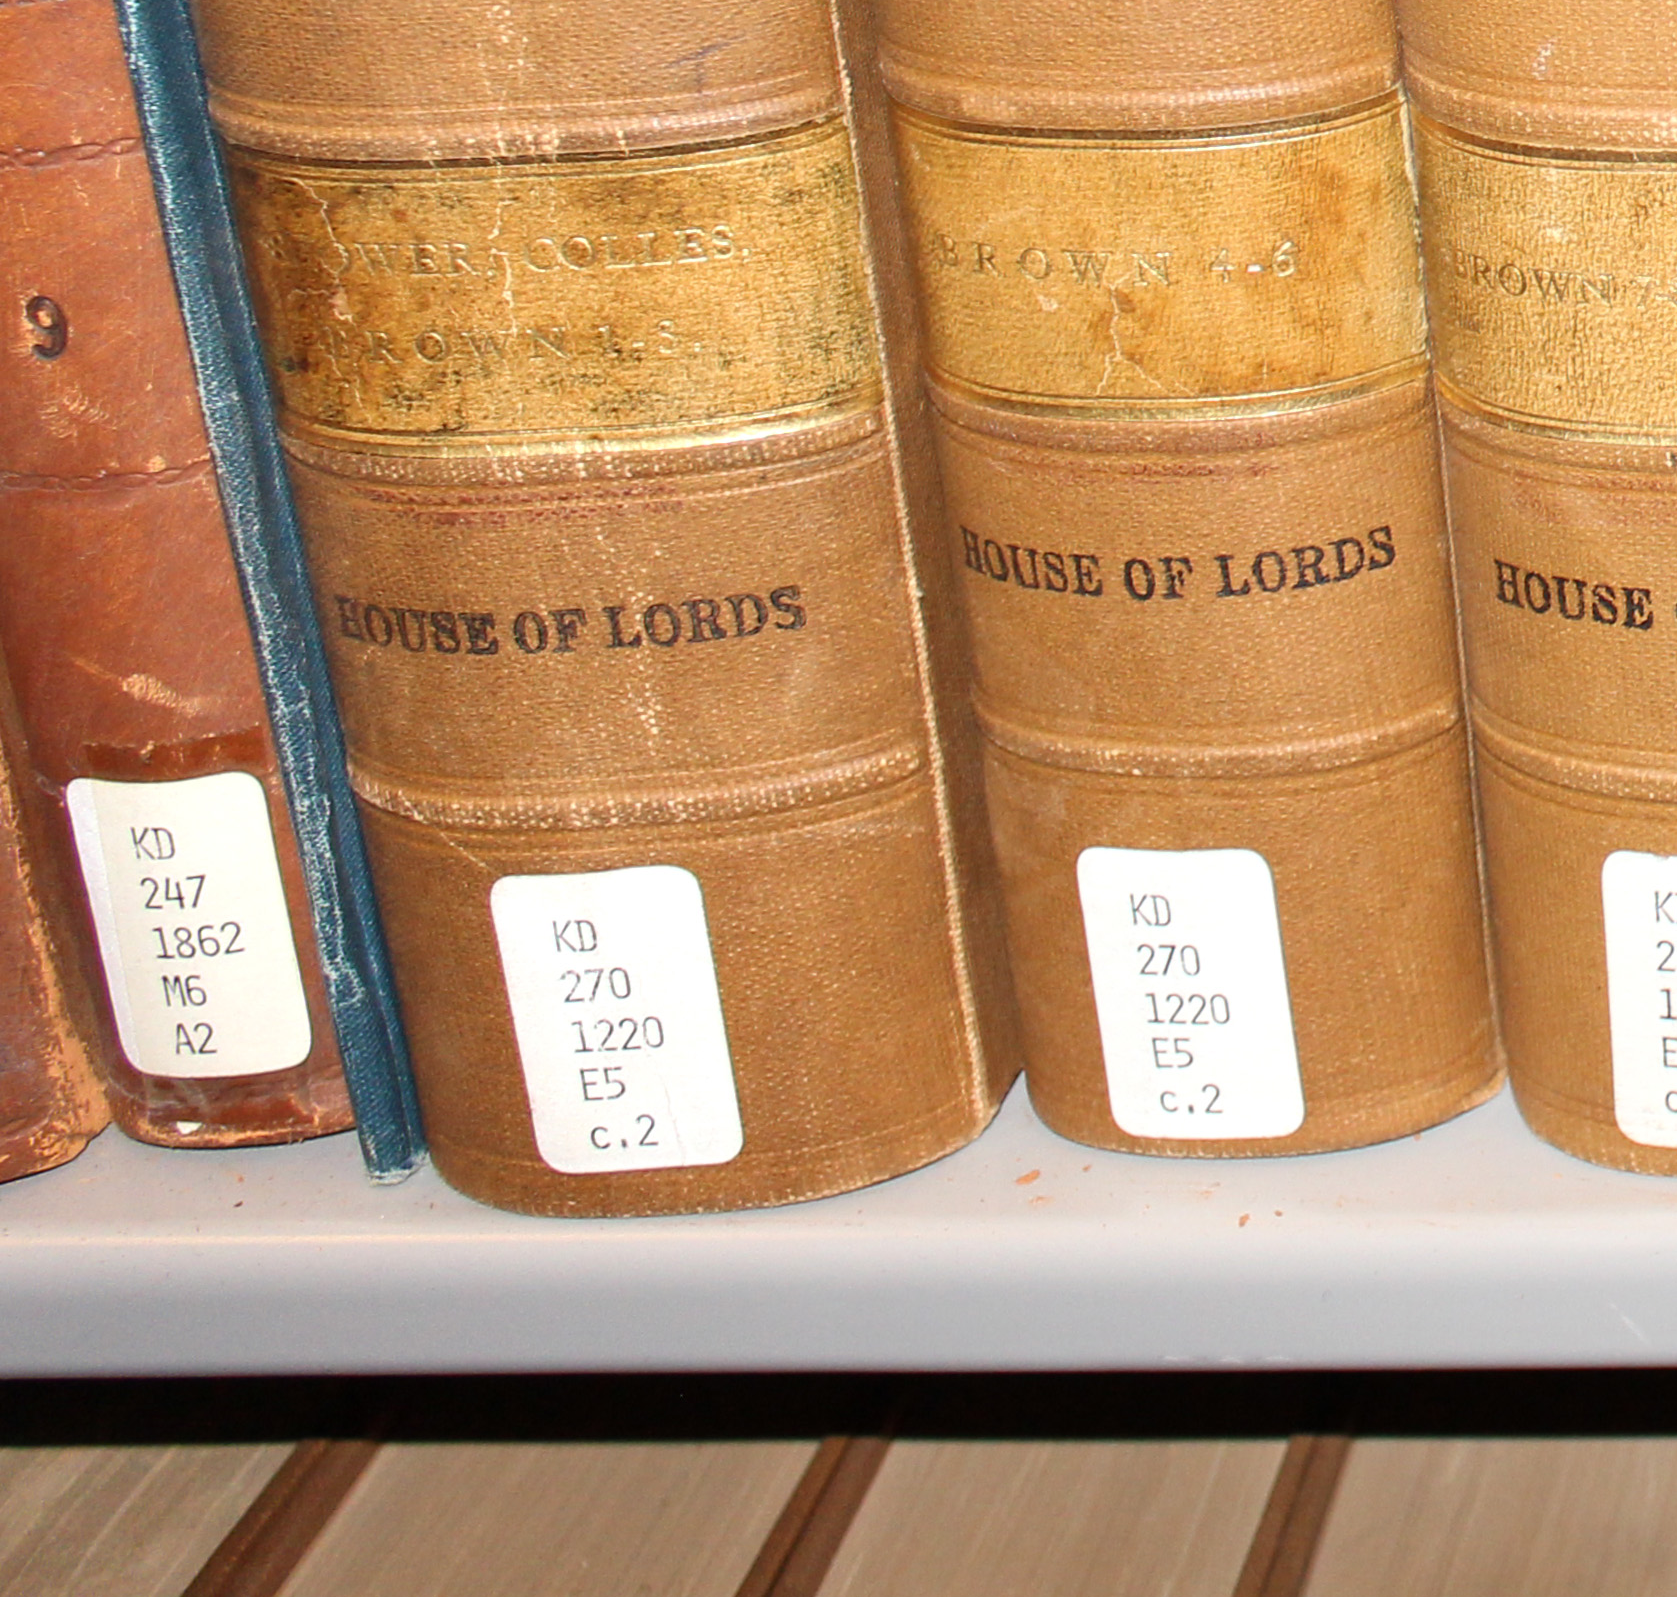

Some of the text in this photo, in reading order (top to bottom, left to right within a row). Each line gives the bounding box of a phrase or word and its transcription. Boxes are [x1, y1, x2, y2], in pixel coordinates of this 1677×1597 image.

[934, 234, 1173, 286] BROWN
[24, 294, 68, 361] 9
[959, 524, 1397, 603] HOUSE OF LORDS
[1493, 558, 1655, 632] HOUSE
[338, 585, 807, 656] HOUSE OF LORDS
[130, 826, 177, 861] KD
[140, 874, 207, 910] 247
[1129, 893, 1172, 927] KD
[152, 921, 246, 960] 1862
[552, 919, 599, 953] KD
[1136, 943, 1201, 976] 270
[161, 974, 208, 1007] M6
[560, 966, 632, 1004] 270
[1144, 992, 1231, 1025] 1220
[175, 1022, 218, 1056] A2
[571, 1015, 665, 1054] 1220
[1151, 1036, 1194, 1069] E5
[579, 1065, 627, 1102] E5
[1159, 1083, 1224, 1115] c.2
[589, 1113, 660, 1151] c.2
